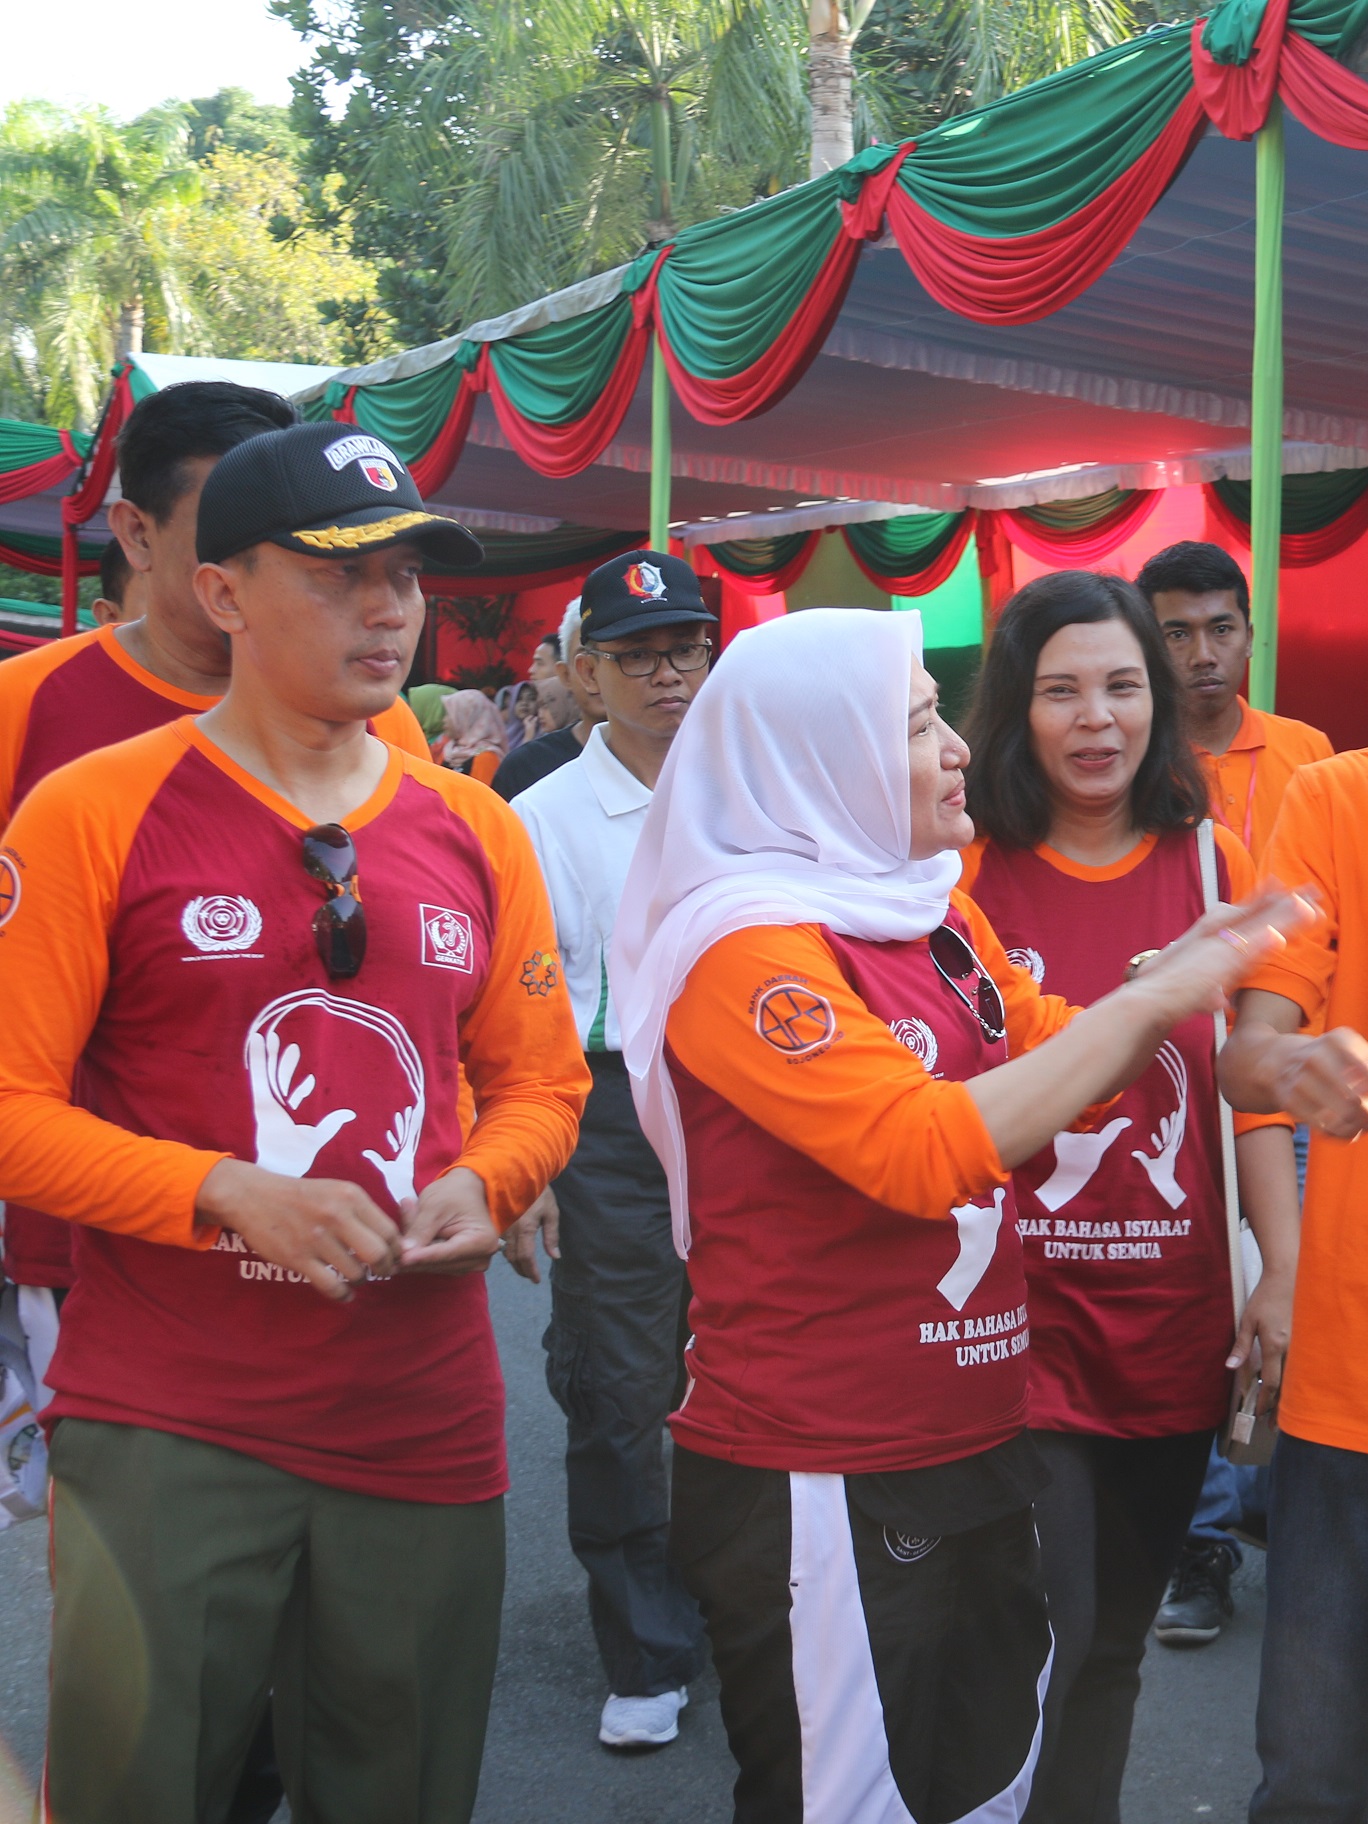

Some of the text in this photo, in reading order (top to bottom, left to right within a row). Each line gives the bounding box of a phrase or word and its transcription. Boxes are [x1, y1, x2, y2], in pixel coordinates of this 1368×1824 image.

[748, 986, 763, 1015] BANK
[1019, 1219, 1191, 1238] HAK BAHASA ISYARAT
[209, 1232, 247, 1253] AK
[1044, 1241, 1162, 1260] UNTUK SEMUA
[240, 1260, 312, 1283] UNTU
[919, 1321, 960, 1344] HAK
[963, 1311, 1017, 1339] BAHASA
[956, 1339, 1009, 1367] UNTUK
